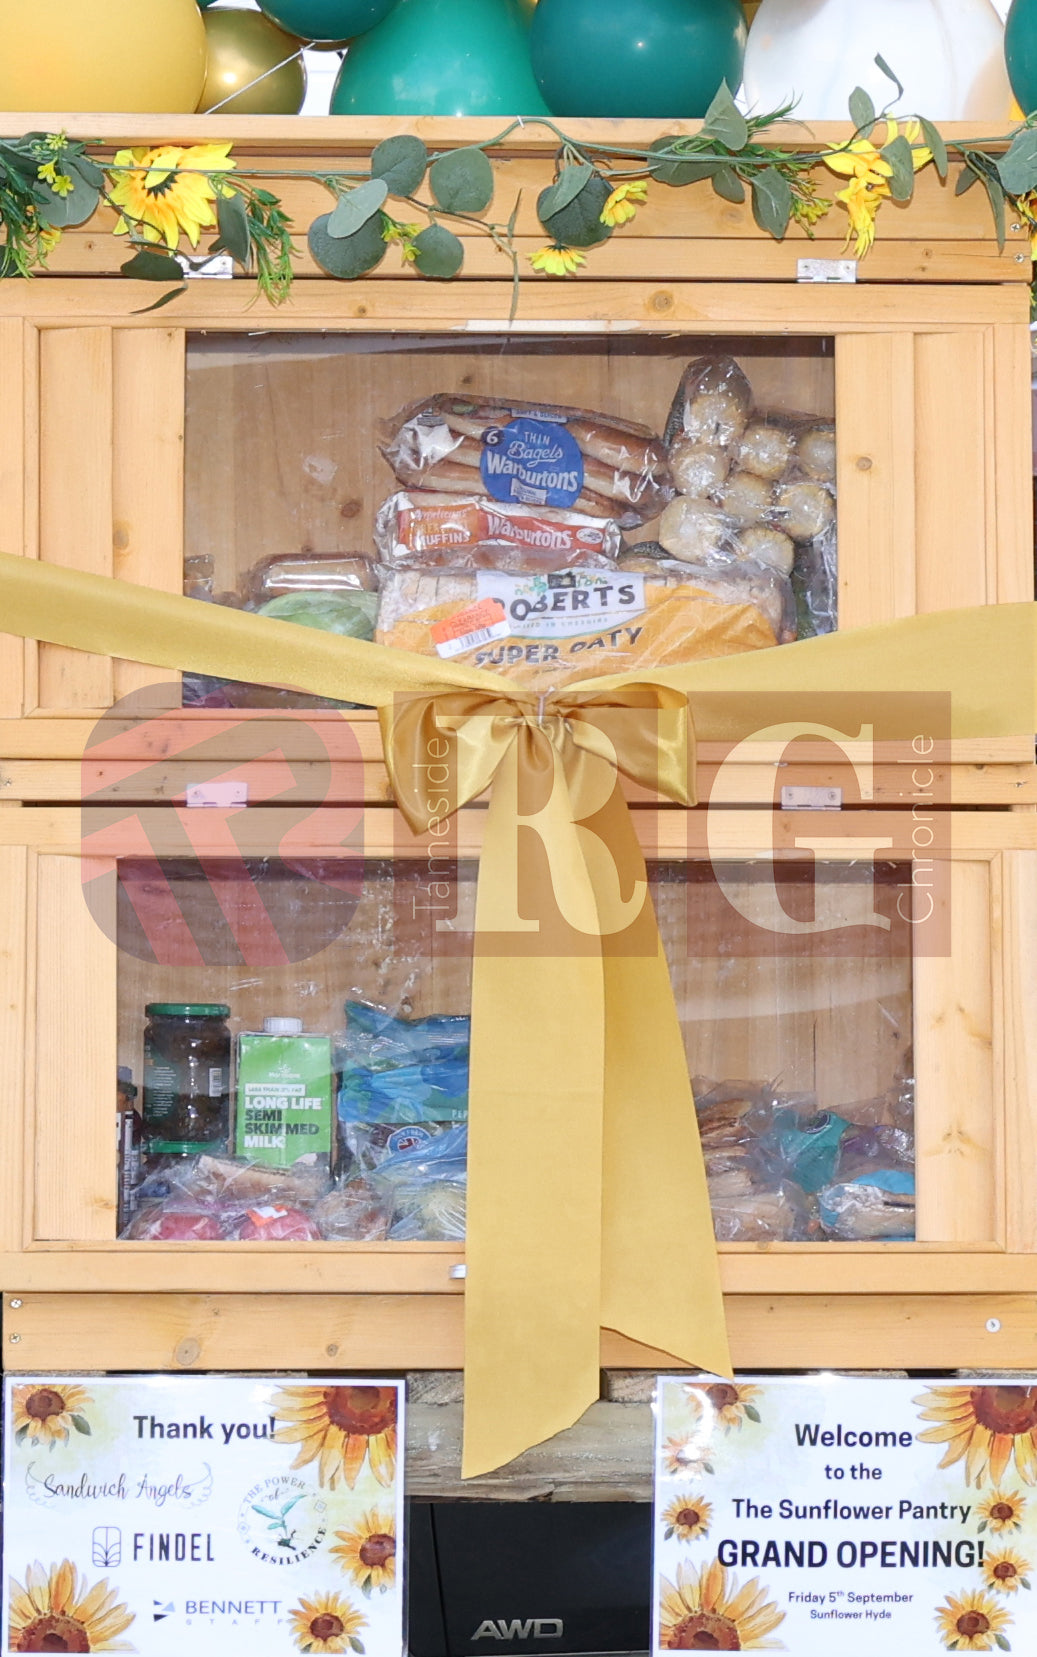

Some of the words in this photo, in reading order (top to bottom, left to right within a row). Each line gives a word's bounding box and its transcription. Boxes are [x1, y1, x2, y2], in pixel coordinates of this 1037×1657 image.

[486, 430, 499, 445] 6
[524, 431, 551, 446] THIN
[507, 440, 564, 468] Bagels
[486, 450, 579, 492] Warburtons
[486, 514, 572, 550] Warburtons
[491, 584, 636, 622] OBERTS
[475, 643, 560, 666] SUPER
[569, 626, 643, 654] OATY
[244, 1096, 289, 1110] LONG
[290, 1097, 322, 1110] LIFE
[245, 1109, 283, 1122] SEMI
[244, 1122, 320, 1135] SKIMMED
[244, 1135, 286, 1149] MILK
[133, 1415, 213, 1440] Thank
[220, 1415, 276, 1445] you!
[794, 1423, 913, 1448] Welcome
[824, 1464, 845, 1480] to
[850, 1462, 882, 1480] the
[44, 1472, 128, 1500] Sandwich
[136, 1473, 193, 1507] Angels
[243, 1483, 263, 1505] THE
[264, 1476, 306, 1490] POWER
[732, 1498, 773, 1519] The
[778, 1499, 893, 1520] Sunflower
[898, 1500, 972, 1524] Pantry
[133, 1533, 215, 1562] FINDEL
[251, 1527, 327, 1566] RESILIENCE
[717, 1539, 828, 1568] GRAND
[836, 1540, 985, 1568] OPENING!
[185, 1600, 282, 1615] BENNETT
[788, 1591, 826, 1605] Friday
[847, 1591, 914, 1605] September
[810, 1609, 863, 1619] Sunflower
[865, 1609, 892, 1621] Hyde
[470, 1618, 564, 1640] AWD
